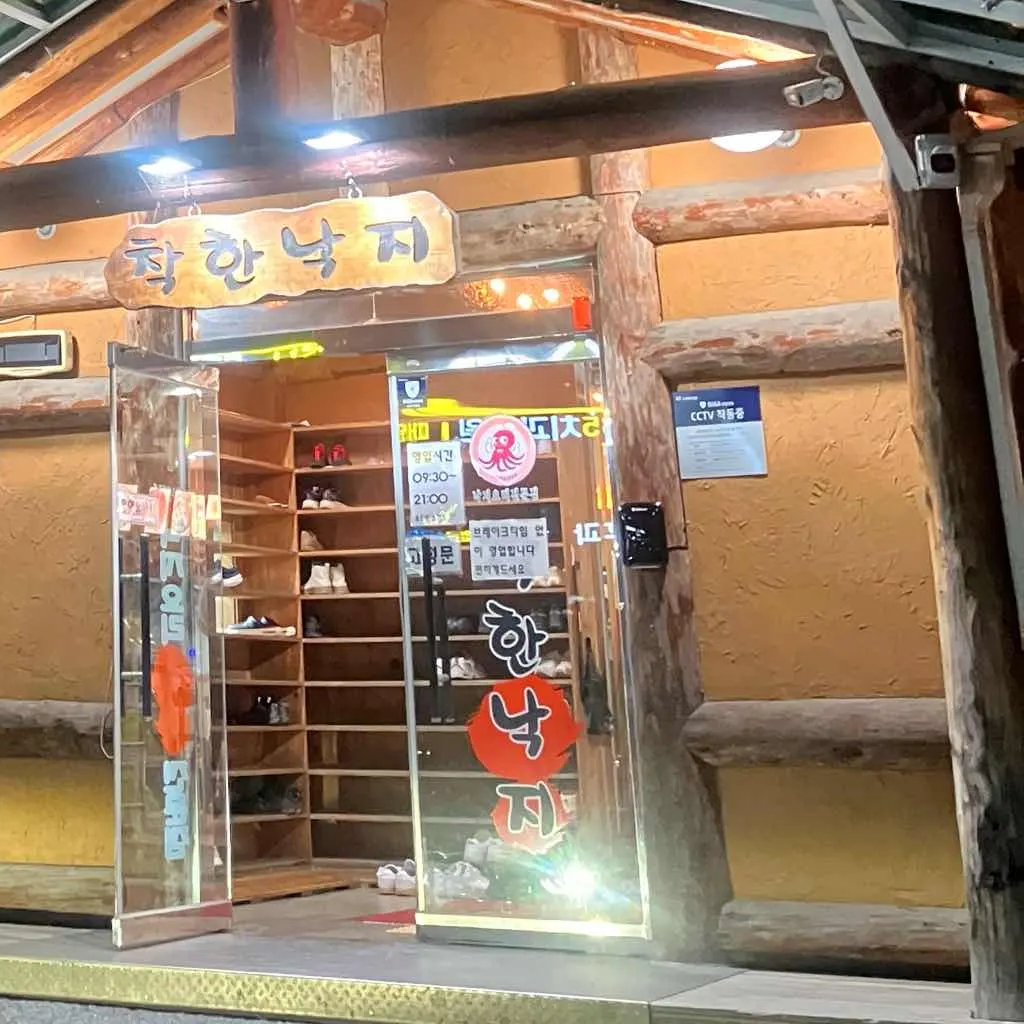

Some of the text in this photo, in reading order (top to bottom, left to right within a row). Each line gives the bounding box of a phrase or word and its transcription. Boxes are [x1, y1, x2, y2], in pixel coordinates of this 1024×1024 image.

[125, 216, 430, 296] 착한낙지
[690, 410, 714, 421] CCTV
[412, 450, 454, 464] 영업시간
[414, 493, 448, 505] 21:00
[473, 525, 528, 538] 브레이크타임
[474, 546, 483, 558] 이
